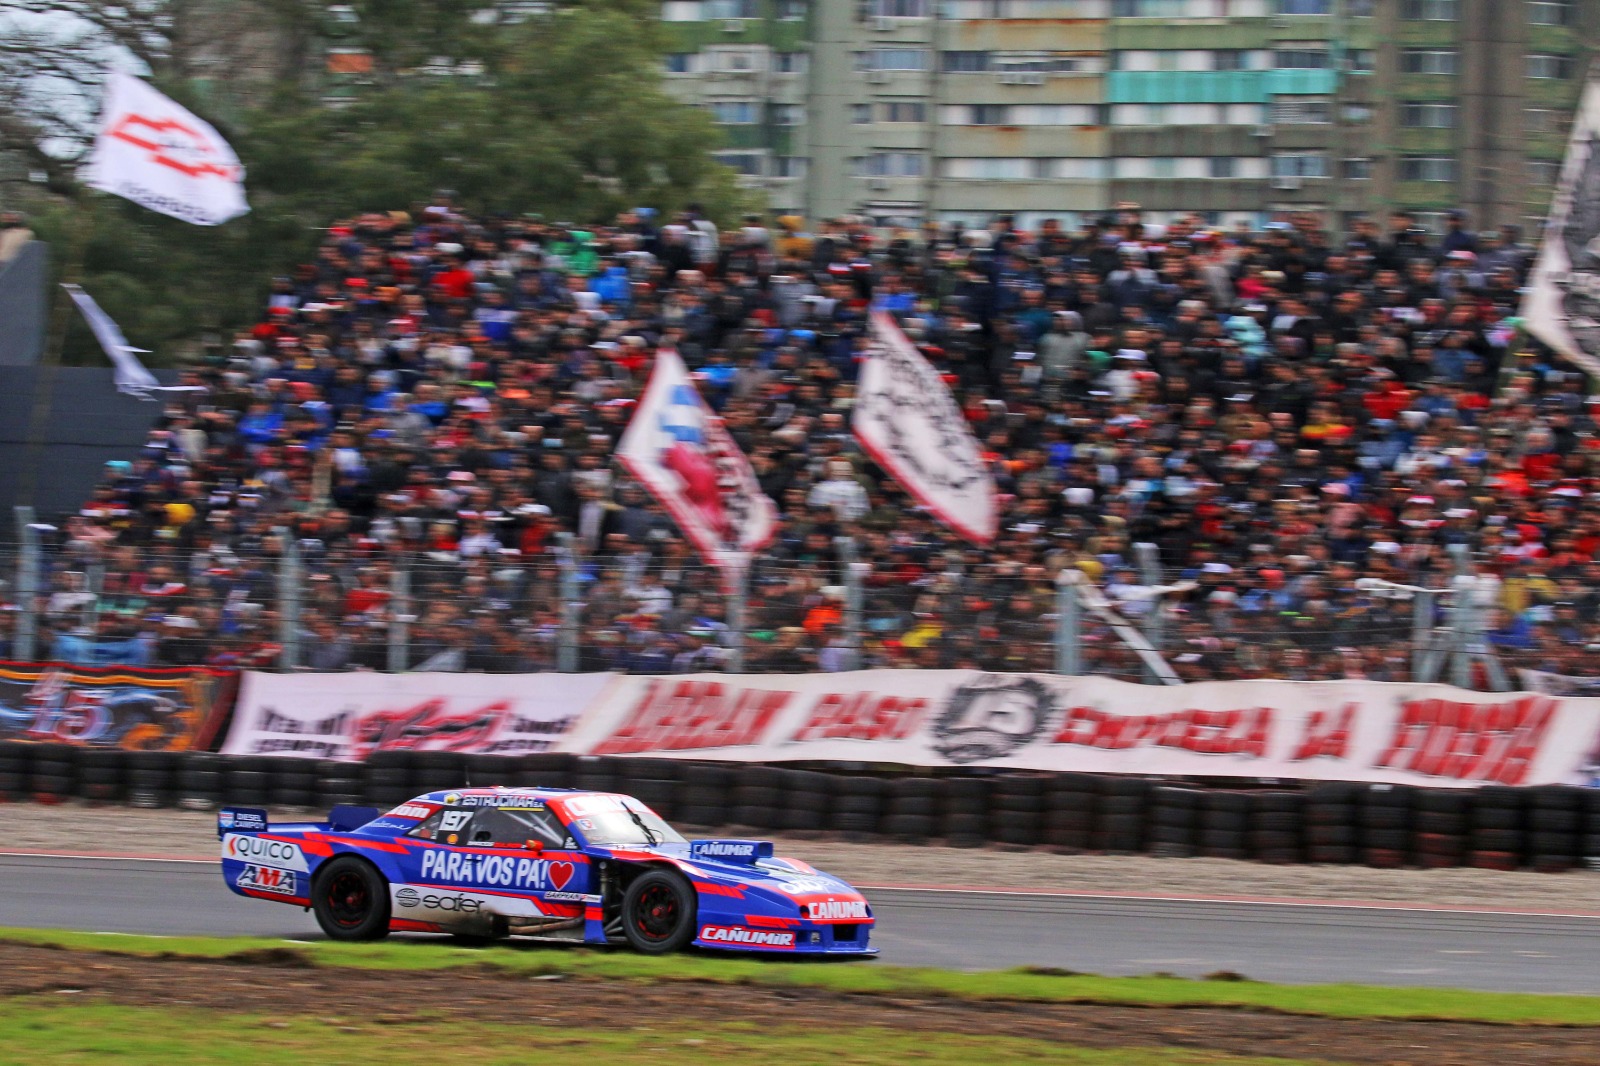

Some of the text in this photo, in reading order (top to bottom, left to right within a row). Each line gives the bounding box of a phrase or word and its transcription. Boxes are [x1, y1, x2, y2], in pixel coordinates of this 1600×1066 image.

[438, 811, 474, 831] 197
[236, 837, 294, 860] QUICO
[239, 865, 294, 890] AMA
[421, 849, 473, 882] PARA
[476, 854, 515, 886] VOS
[422, 892, 486, 913] safer
